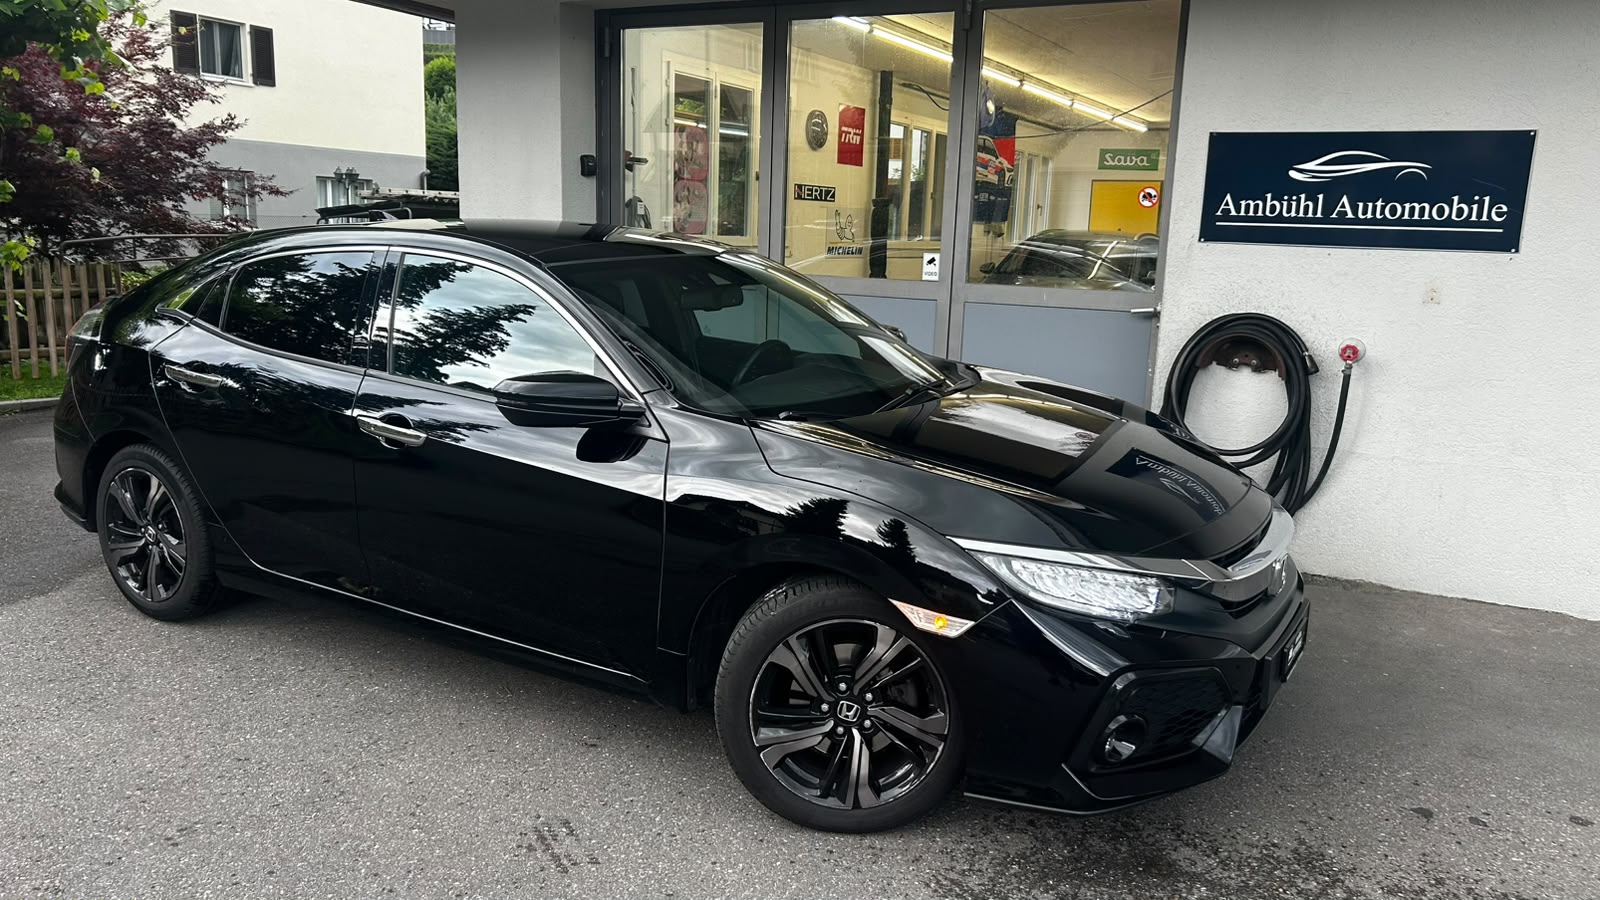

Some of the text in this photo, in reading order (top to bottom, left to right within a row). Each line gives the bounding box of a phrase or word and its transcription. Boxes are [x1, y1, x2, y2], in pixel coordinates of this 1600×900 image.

[841, 126, 861, 145] TRW
[795, 185, 835, 201] HERTZ
[1215, 192, 1509, 222] Ambühl Automobile
[827, 246, 863, 255] MICHELIN
